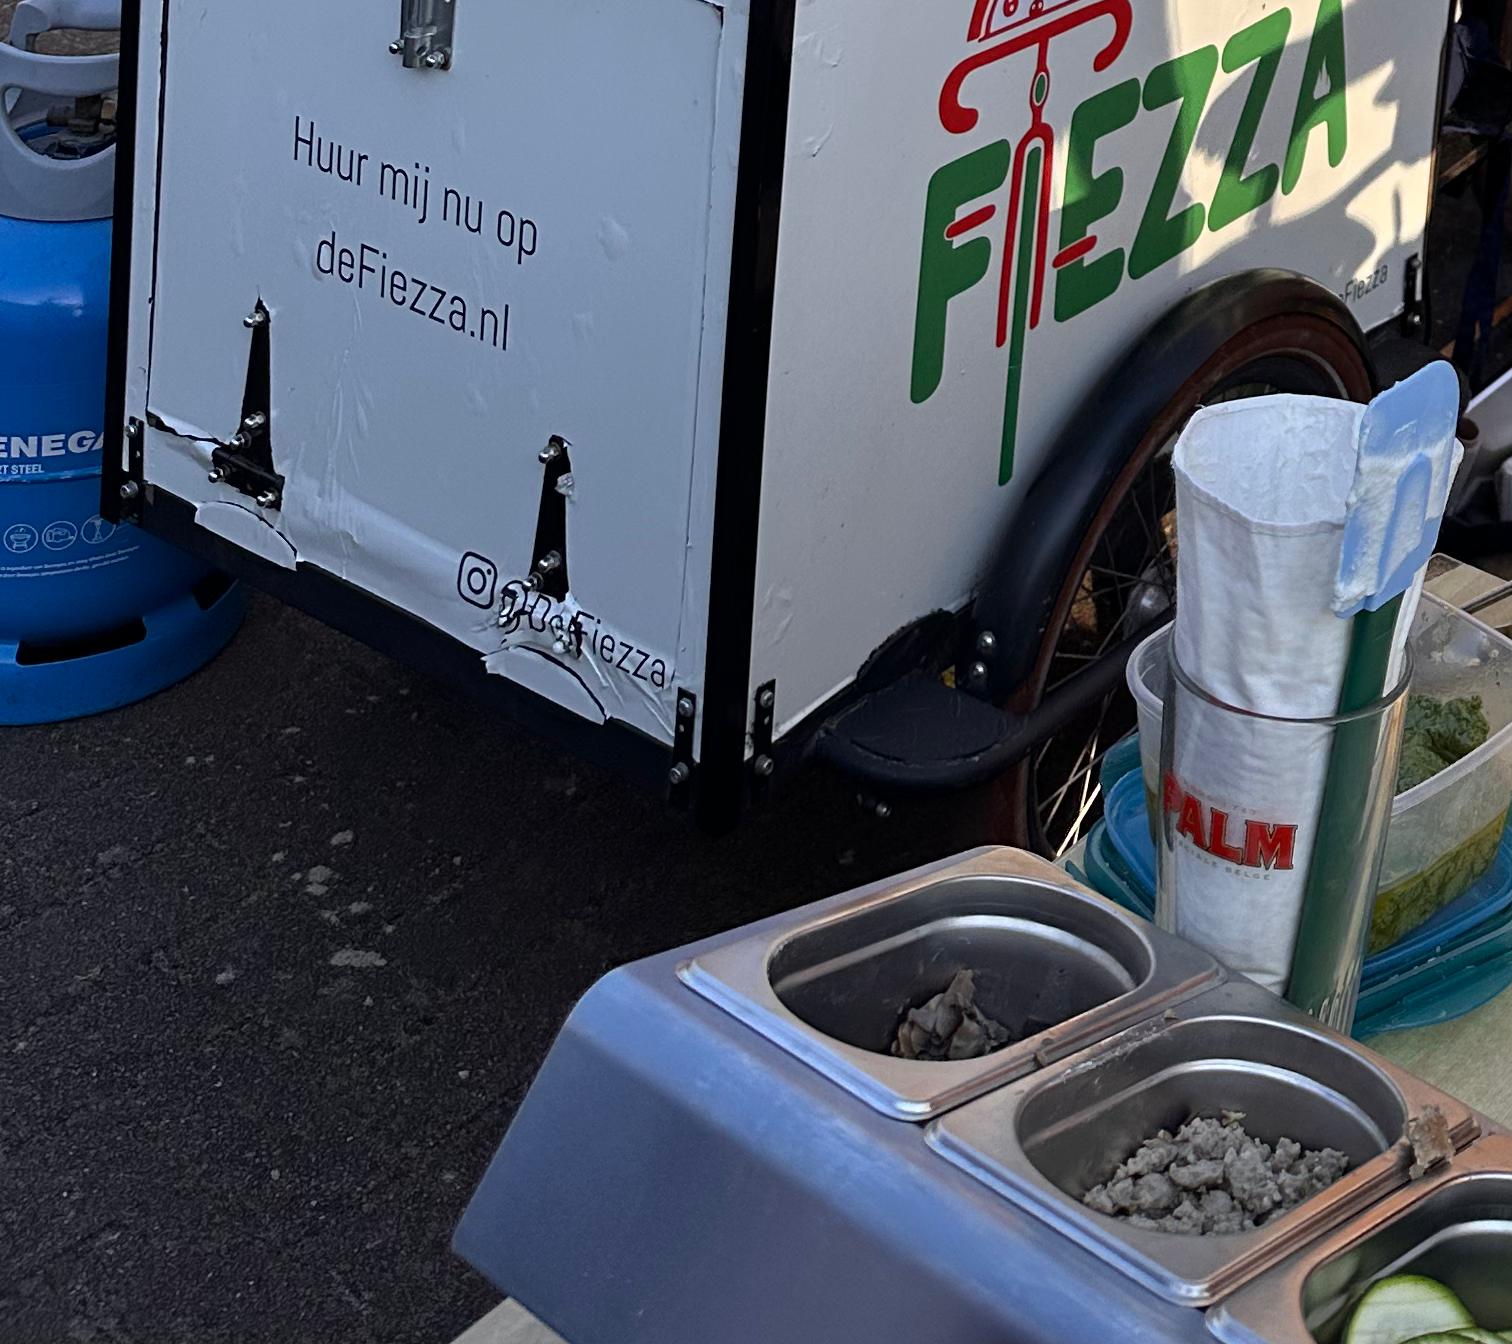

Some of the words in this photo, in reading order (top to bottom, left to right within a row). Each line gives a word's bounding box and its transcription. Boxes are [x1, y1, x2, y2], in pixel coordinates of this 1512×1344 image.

[294, 115, 369, 187] Huur
[379, 162, 431, 224] mij
[442, 186, 484, 236] nu
[496, 209, 538, 265] op
[316, 230, 510, 352] deFiezza.nl
[11, 463, 45, 475] STEEL
[1162, 768, 1299, 871] PALM
